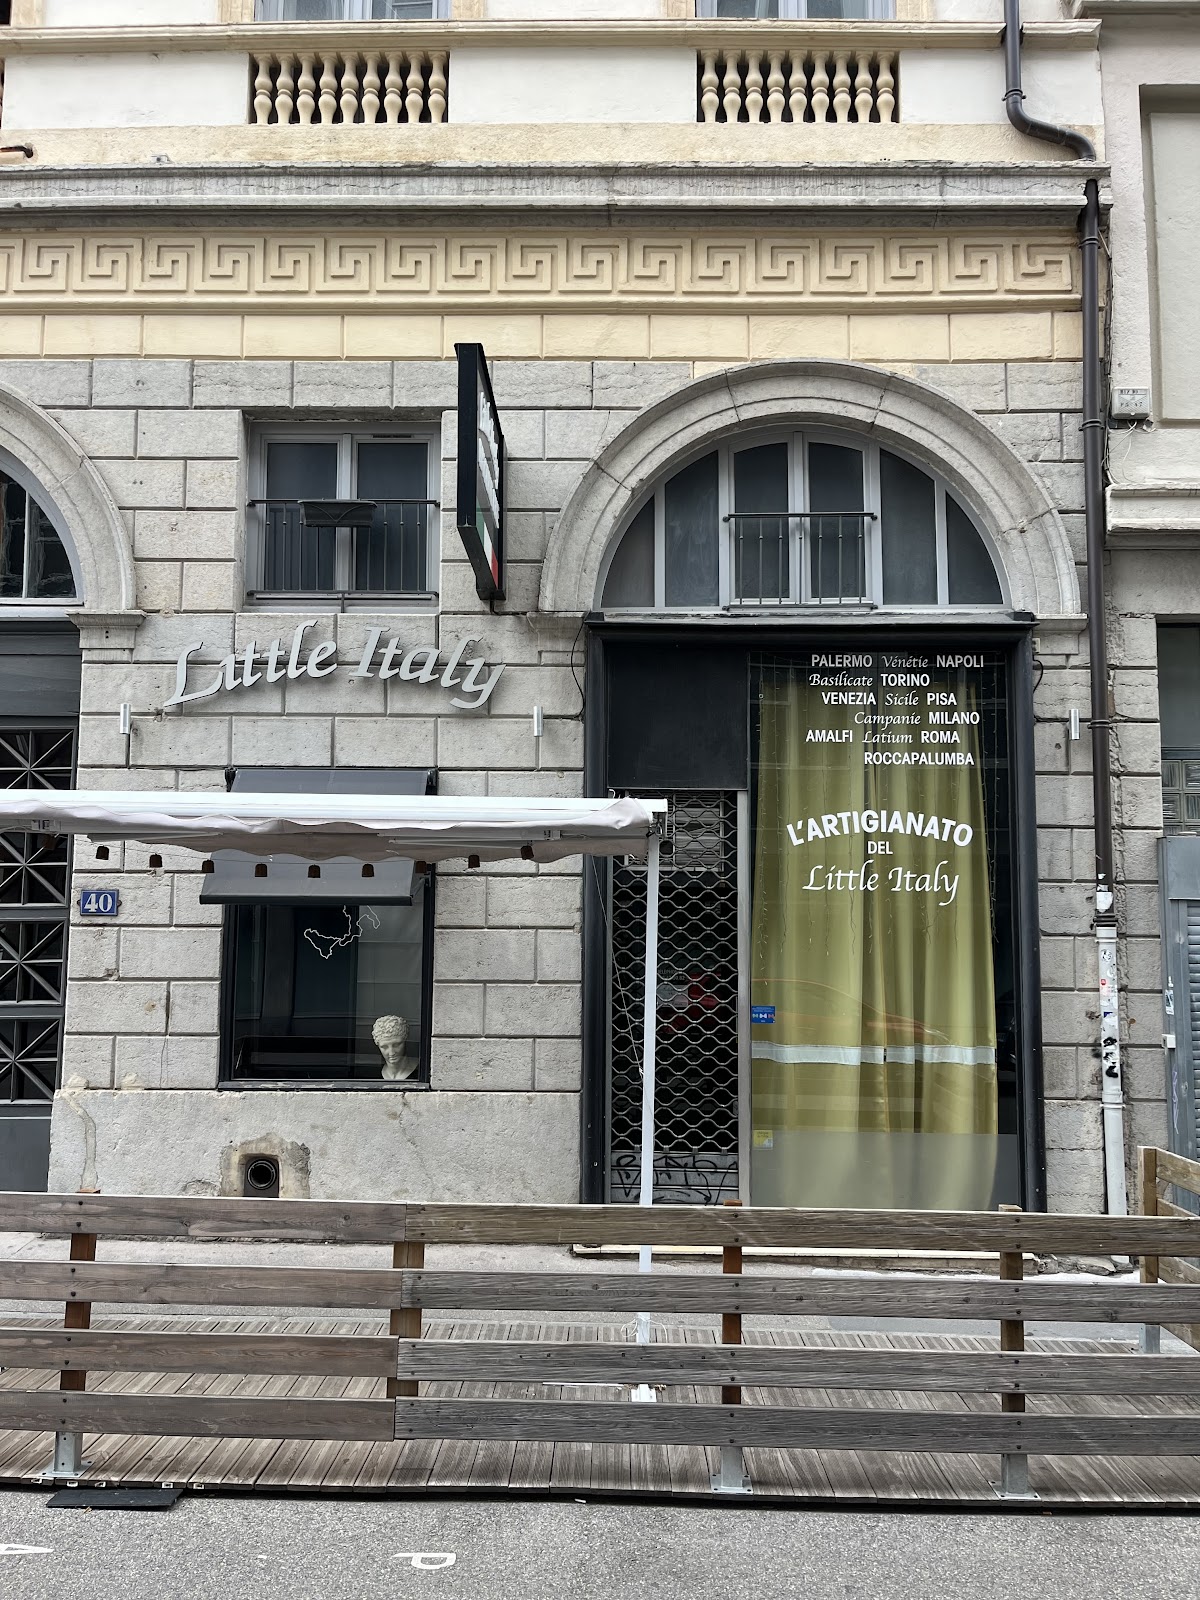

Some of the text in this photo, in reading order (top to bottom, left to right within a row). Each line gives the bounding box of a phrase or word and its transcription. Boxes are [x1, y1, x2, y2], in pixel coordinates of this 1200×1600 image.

[163, 619, 507, 710] Little Italy
[812, 655, 983, 667] PALERMO Vénétie NAPOLI
[809, 671, 929, 686] Basilicate TORINO
[822, 691, 956, 705] VENEZIA Sicile PISA
[855, 712, 979, 730] Campanie MILANO
[806, 730, 960, 743] AMALFI Latium ROMA
[865, 752, 974, 765] ROCCAPALUMBA
[868, 841, 893, 854] DEL
[803, 860, 959, 905] Little Italy
[84, 893, 113, 913] 40
